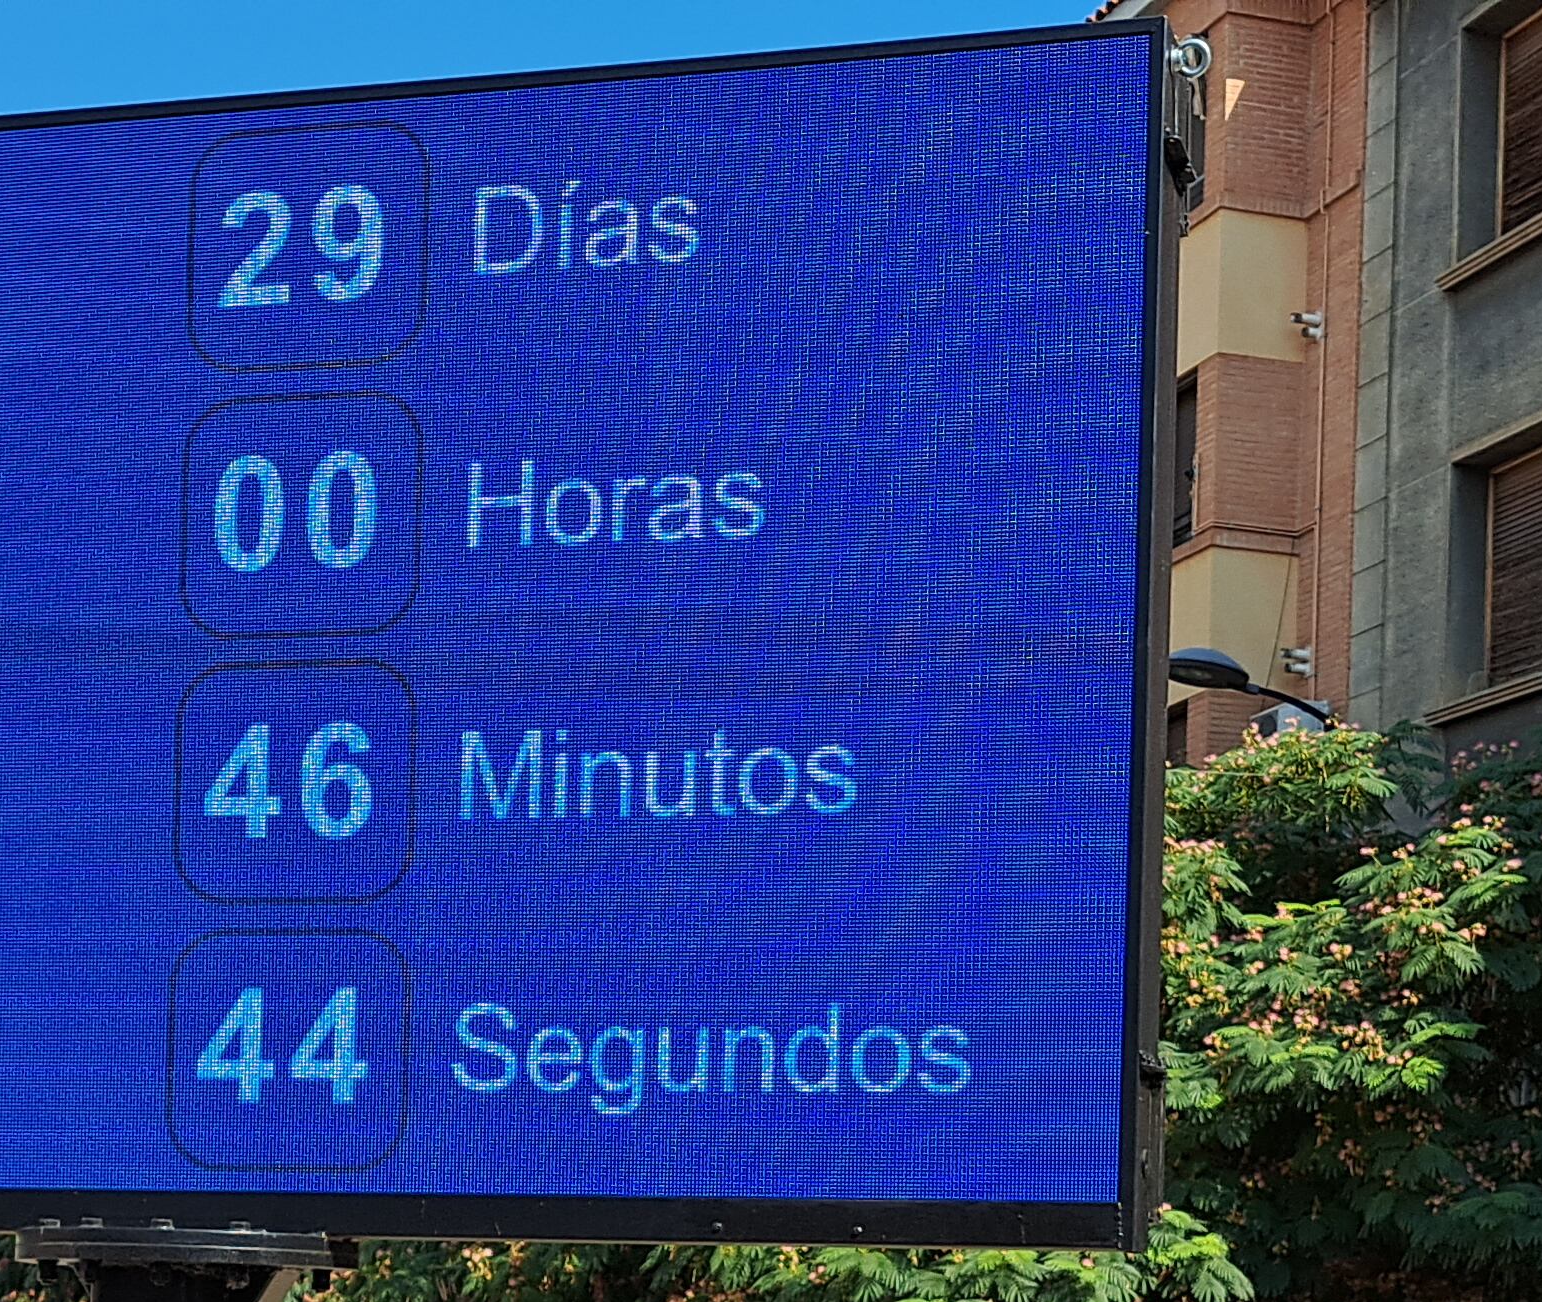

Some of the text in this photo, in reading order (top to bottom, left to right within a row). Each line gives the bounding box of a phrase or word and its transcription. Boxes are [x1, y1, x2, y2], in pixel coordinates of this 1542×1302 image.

[218, 184, 383, 308] 29
[474, 180, 700, 275] Días
[213, 450, 377, 572] 00
[466, 460, 767, 550] Horas
[203, 720, 373, 840] 46
[459, 729, 857, 820] Minutos
[196, 986, 369, 1104] 44
[453, 1001, 974, 1115] Segundos
